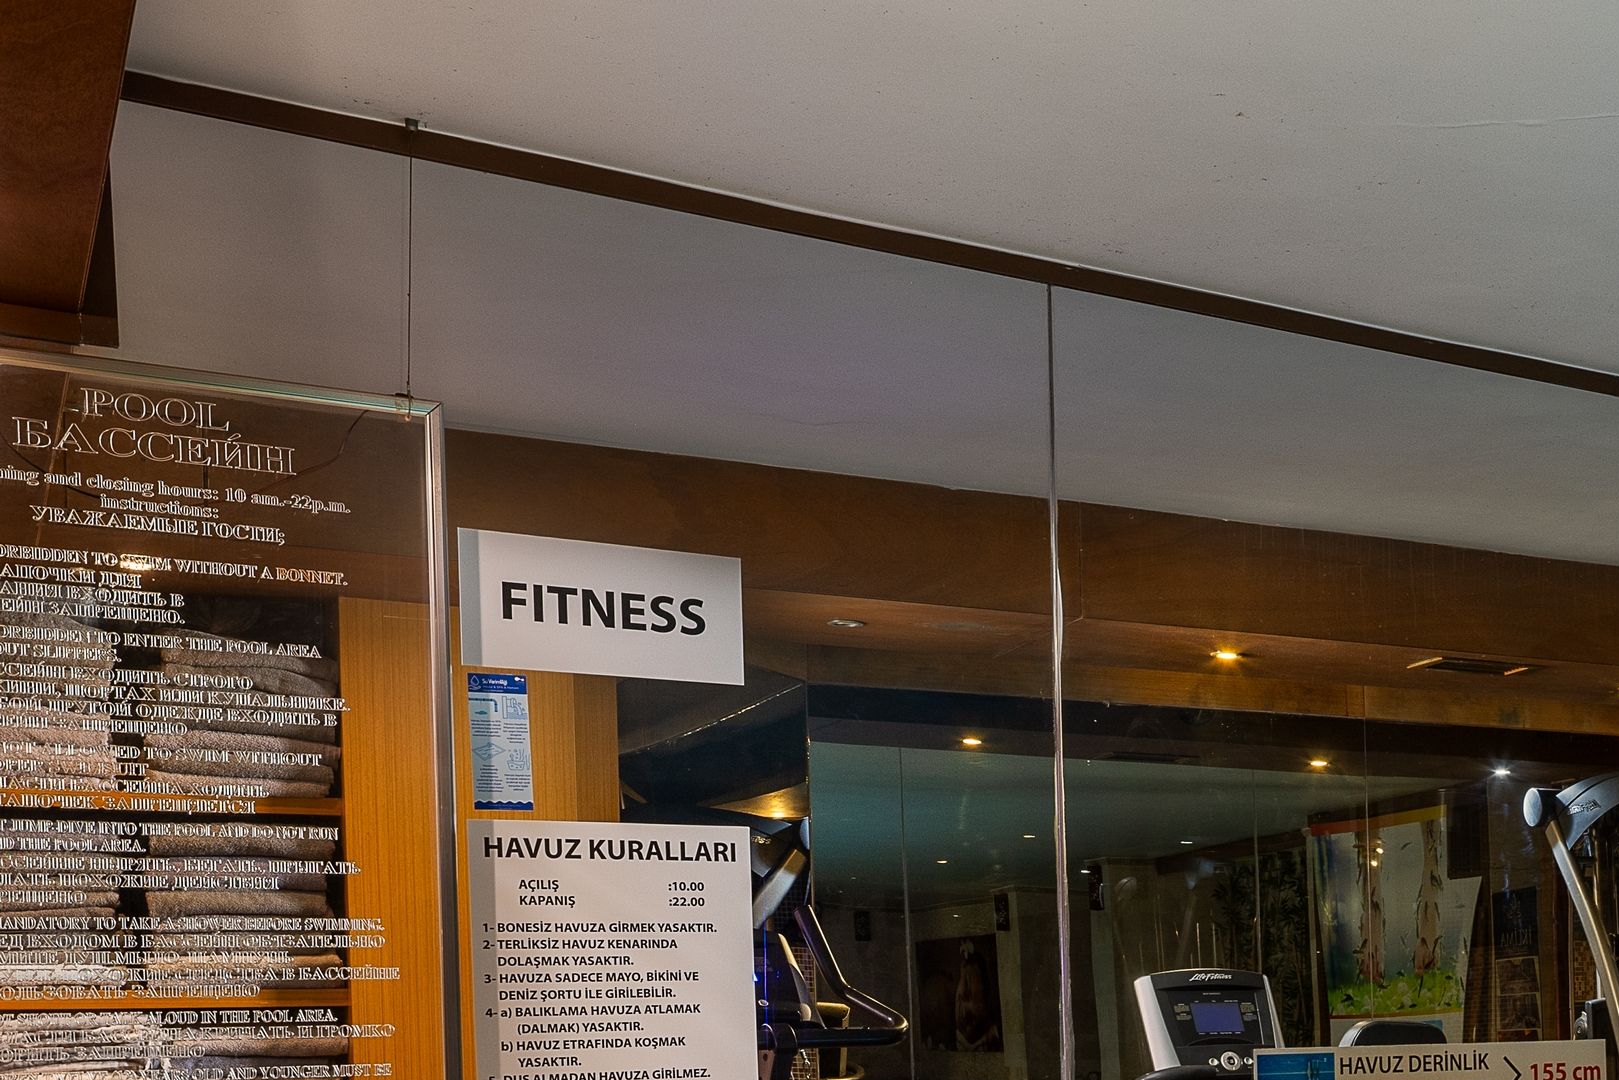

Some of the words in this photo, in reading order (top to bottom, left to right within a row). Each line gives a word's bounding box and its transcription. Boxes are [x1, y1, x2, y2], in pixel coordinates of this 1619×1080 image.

[81, 387, 230, 432] POOL
[12, 416, 297, 476] БАССЕЙН
[44, 471, 81, 487] and
[86, 474, 154, 497] closing
[158, 480, 219, 500] hours:
[225, 487, 246, 503] 10
[100, 493, 219, 518] instructions:
[29, 505, 198, 536] УВАЖАЕМЫЕ
[175, 558, 257, 580] WITHOUT
[501, 581, 706, 636] FITNESS
[483, 836, 582, 860] HAVUZ
[588, 839, 737, 863] KURALLARI
[518, 879, 560, 893] AÇILIŞ
[668, 881, 705, 892] :10.00
[519, 895, 576, 909] KAPANIŞ
[668, 896, 705, 907] :22.00
[482, 922, 495, 933] 1-
[497, 920, 552, 933] BONESİZ
[554, 922, 607, 933] HAVUZA
[608, 920, 656, 933] GİRMEK
[657, 922, 718, 933] YASAKTIR.
[482, 939, 496, 950] 2-
[496, 937, 560, 950] TERLİKSİZ
[561, 939, 605, 950] HAVUZ
[607, 938, 678, 949] KENARINDA
[497, 956, 570, 969] DOLAŞMAK
[571, 955, 634, 966] YASAKTIR.
[484, 973, 497, 984] 3-
[499, 973, 553, 984] HAVUZA
[555, 972, 603, 983] SADECE
[605, 972, 644, 983] MAYO,
[646, 969, 682, 982] BİKİNİ
[683, 971, 699, 981] VE
[498, 987, 538, 1001] DENİZ
[540, 989, 582, 1003] ŞORTU
[584, 987, 603, 999] İLE
[605, 986, 677, 999] GİRİLEBİLİR.
[485, 1007, 498, 1018] 4-
[500, 1007, 512, 1019] a)
[515, 1006, 588, 1018] BALIKLAMA
[590, 1004, 642, 1016] HAVUZA
[644, 1003, 701, 1015] ATLAMAK
[517, 1022, 580, 1036] (DALMAK)
[581, 1021, 644, 1033] YASAKTIR.
[500, 1040, 514, 1053] b)
[516, 1040, 561, 1051] HAVUZ
[562, 1038, 633, 1050] ETRAFINDA
[634, 1036, 686, 1050] KOŞMAK
[517, 1056, 582, 1068] YASAKTIR.
[1339, 1055, 1404, 1075] HAVUZ
[1408, 1049, 1490, 1073] DERİNLİK
[652, 1067, 711, 1080] GİRİLMEZ.
